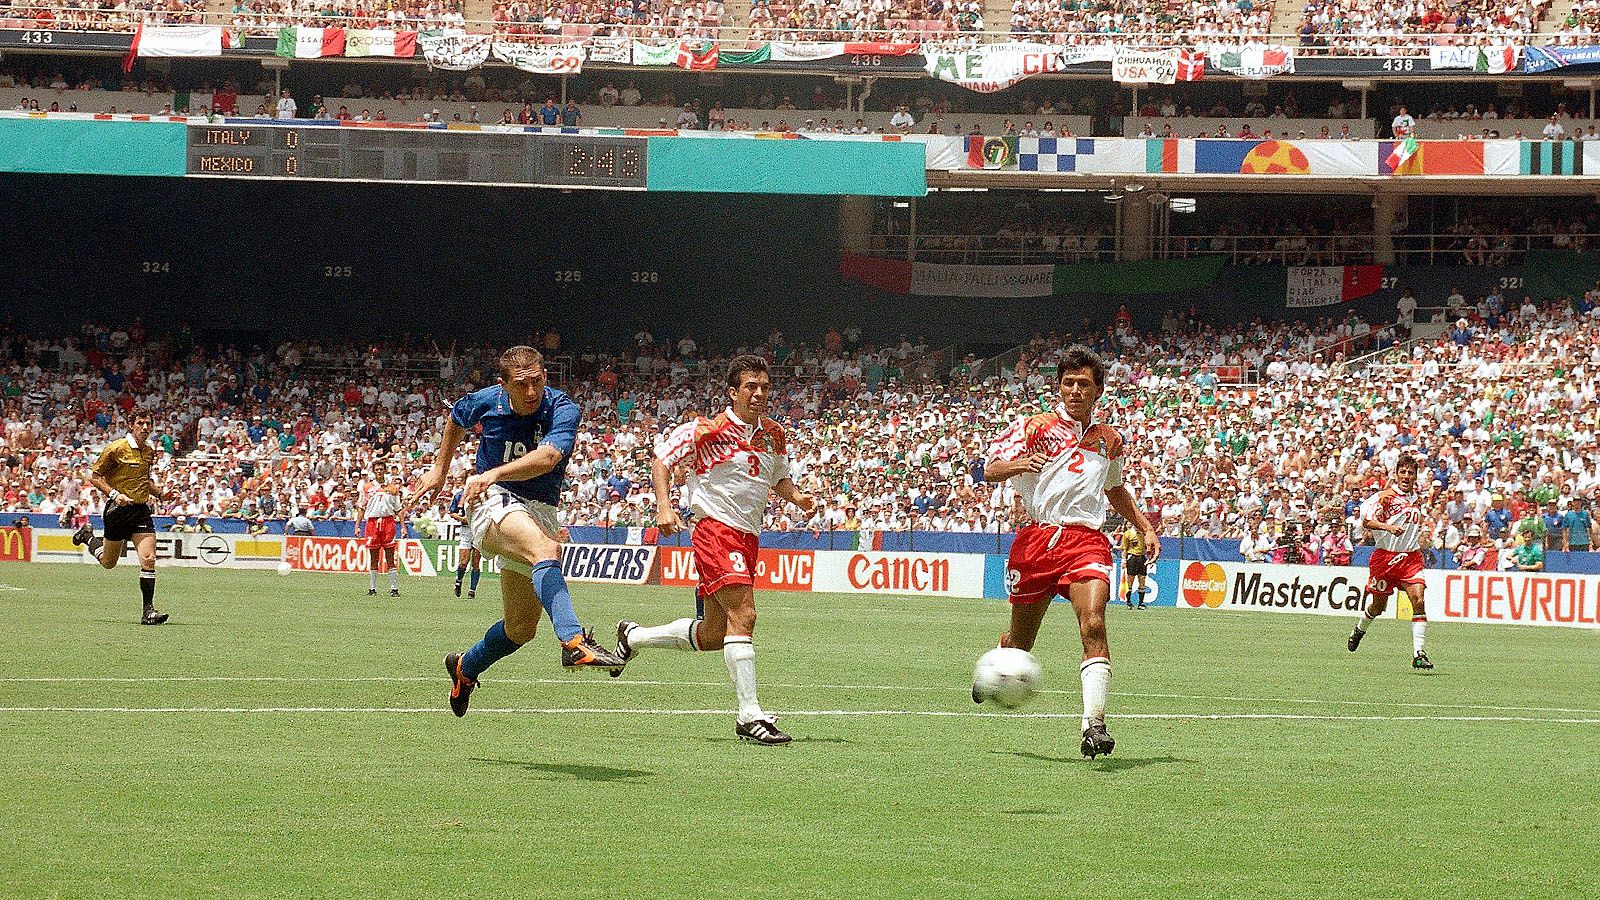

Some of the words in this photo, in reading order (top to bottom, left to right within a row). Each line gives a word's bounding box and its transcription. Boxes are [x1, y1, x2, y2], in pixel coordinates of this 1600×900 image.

[21, 31, 53, 44] 433
[851, 54, 881, 66] 436
[1117, 57, 1173, 67] CHIHUAHUA
[1382, 59, 1414, 72] 438
[1117, 66, 1148, 79] USA
[207, 130, 251, 145] ITALY
[286, 130, 299, 149] 0
[201, 156, 254, 172] MEXICO
[286, 156, 298, 175] 0
[142, 261, 170, 273] 324
[324, 266, 352, 277] 325
[1381, 277, 1398, 289] 27
[1500, 277, 1523, 289] 321
[747, 454, 760, 477] 3
[1067, 451, 1085, 474] 2
[1404, 511, 1419, 525] 20
[562, 546, 650, 580] ICKERS
[729, 551, 746, 572] 3
[770, 555, 812, 584] JVC
[847, 553, 949, 592] Canon
[1009, 570, 1021, 593] 2
[1183, 578, 1227, 592] MasterCard
[1369, 577, 1387, 592] 20
[1444, 575, 1600, 623] CHEVROL
